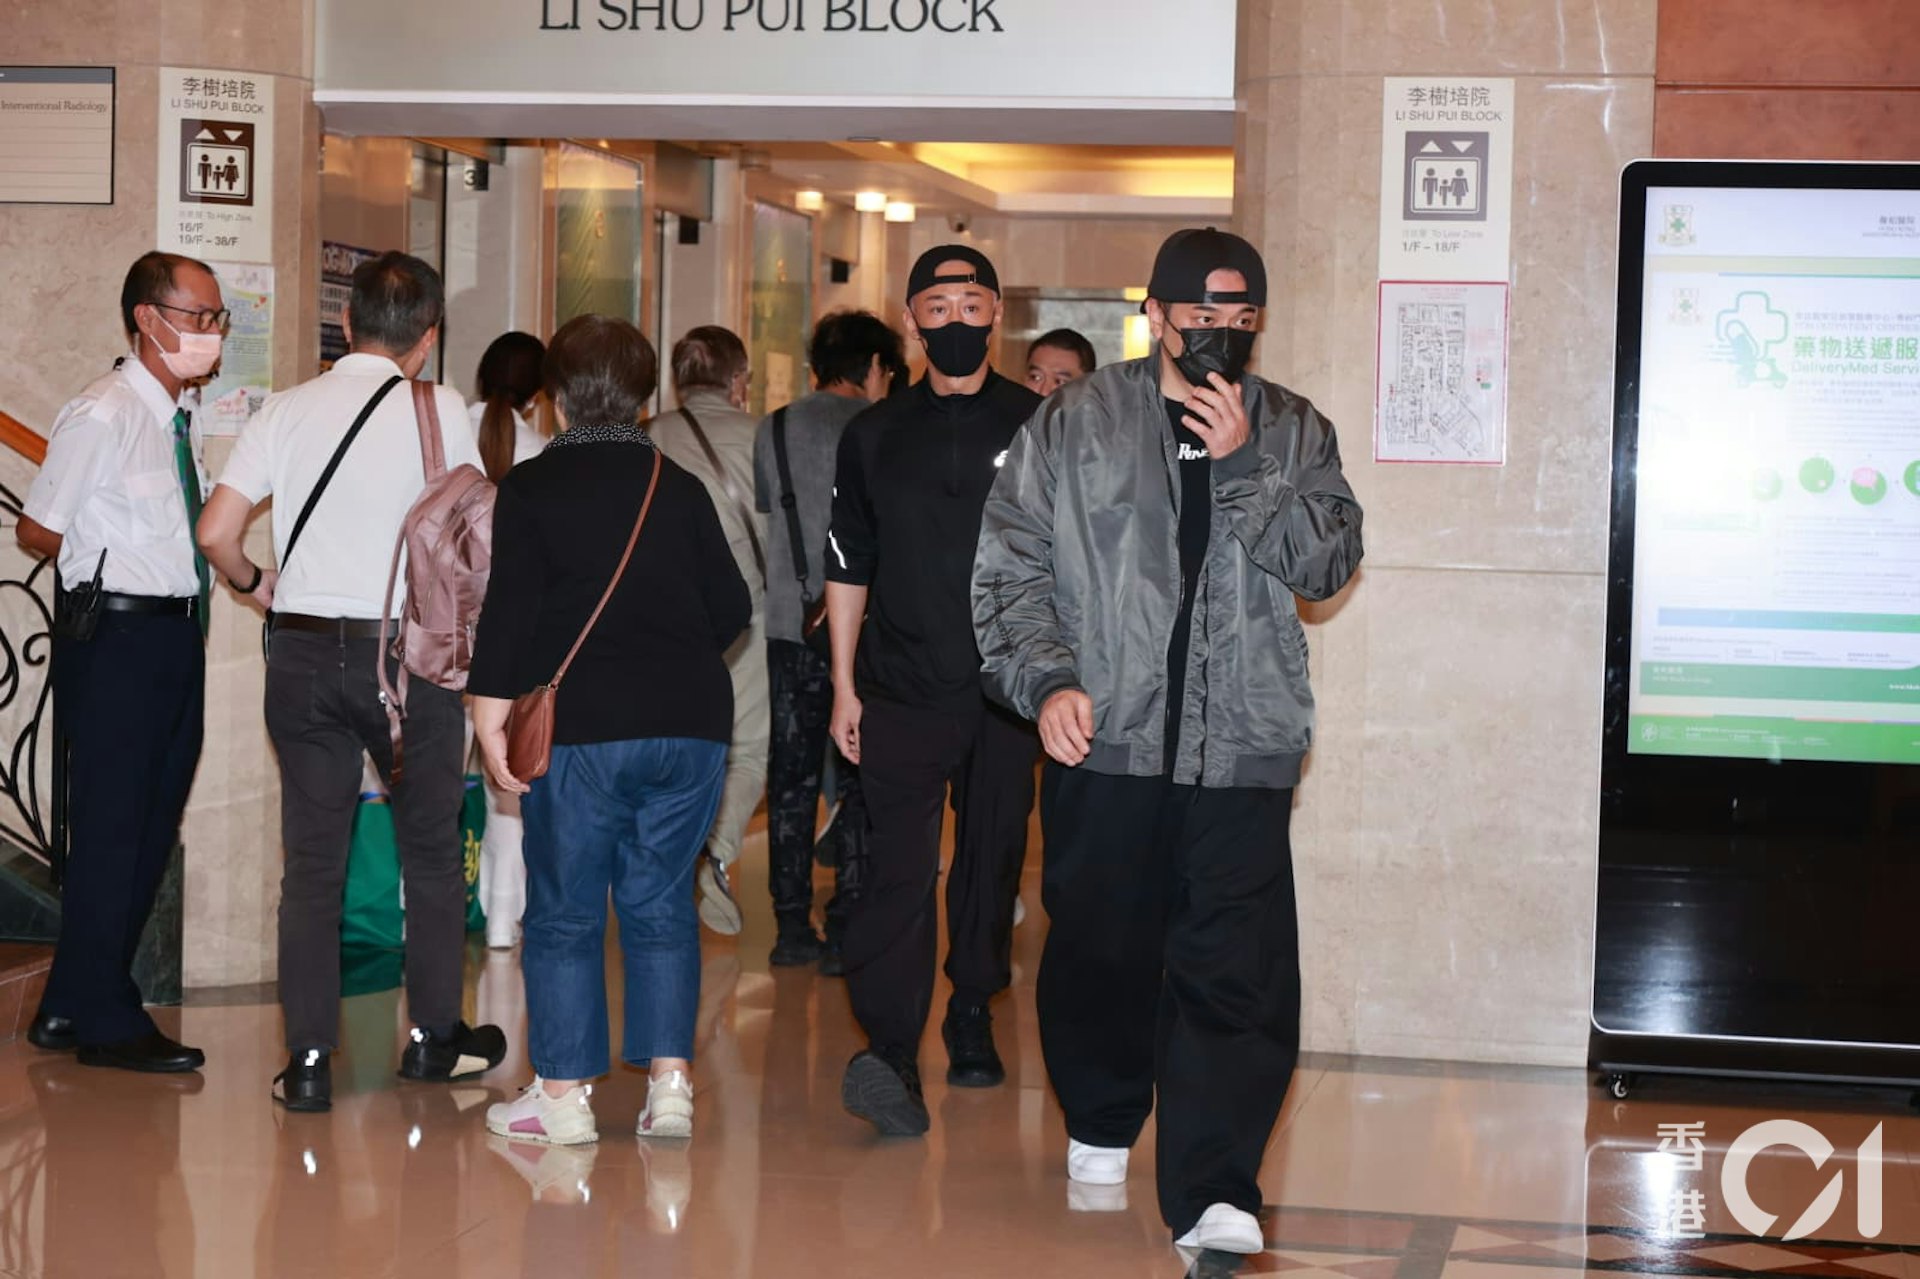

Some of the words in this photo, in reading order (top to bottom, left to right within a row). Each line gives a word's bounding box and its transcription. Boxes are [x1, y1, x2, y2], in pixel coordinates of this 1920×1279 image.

[539, 0, 581, 31] LI
[597, 0, 703, 32] SHU
[723, 0, 805, 32] PUI
[823, 0, 1005, 32] BLOCK
[182, 76, 256, 99] 李樹培院
[1407, 85, 1490, 107] 李樹培院
[64, 100, 106, 113] Radiology
[171, 98, 181, 108] LI
[183, 98, 208, 110] SHU
[210, 100, 229, 111] PUI
[231, 102, 264, 114] BLOCK
[1395, 109, 1406, 121] LI
[1409, 110, 1435, 121] SHU
[1437, 110, 1458, 121] PUI
[1460, 110, 1503, 121] BLOCK
[464, 169, 476, 186] 3
[179, 222, 203, 233] 16/F
[179, 234, 203, 245] 19/F
[214, 235, 240, 247] 38/F
[1402, 241, 1421, 252] 1/F
[1435, 241, 1460, 253] 18/F
[1792, 362, 1878, 375] DeliveryMed
